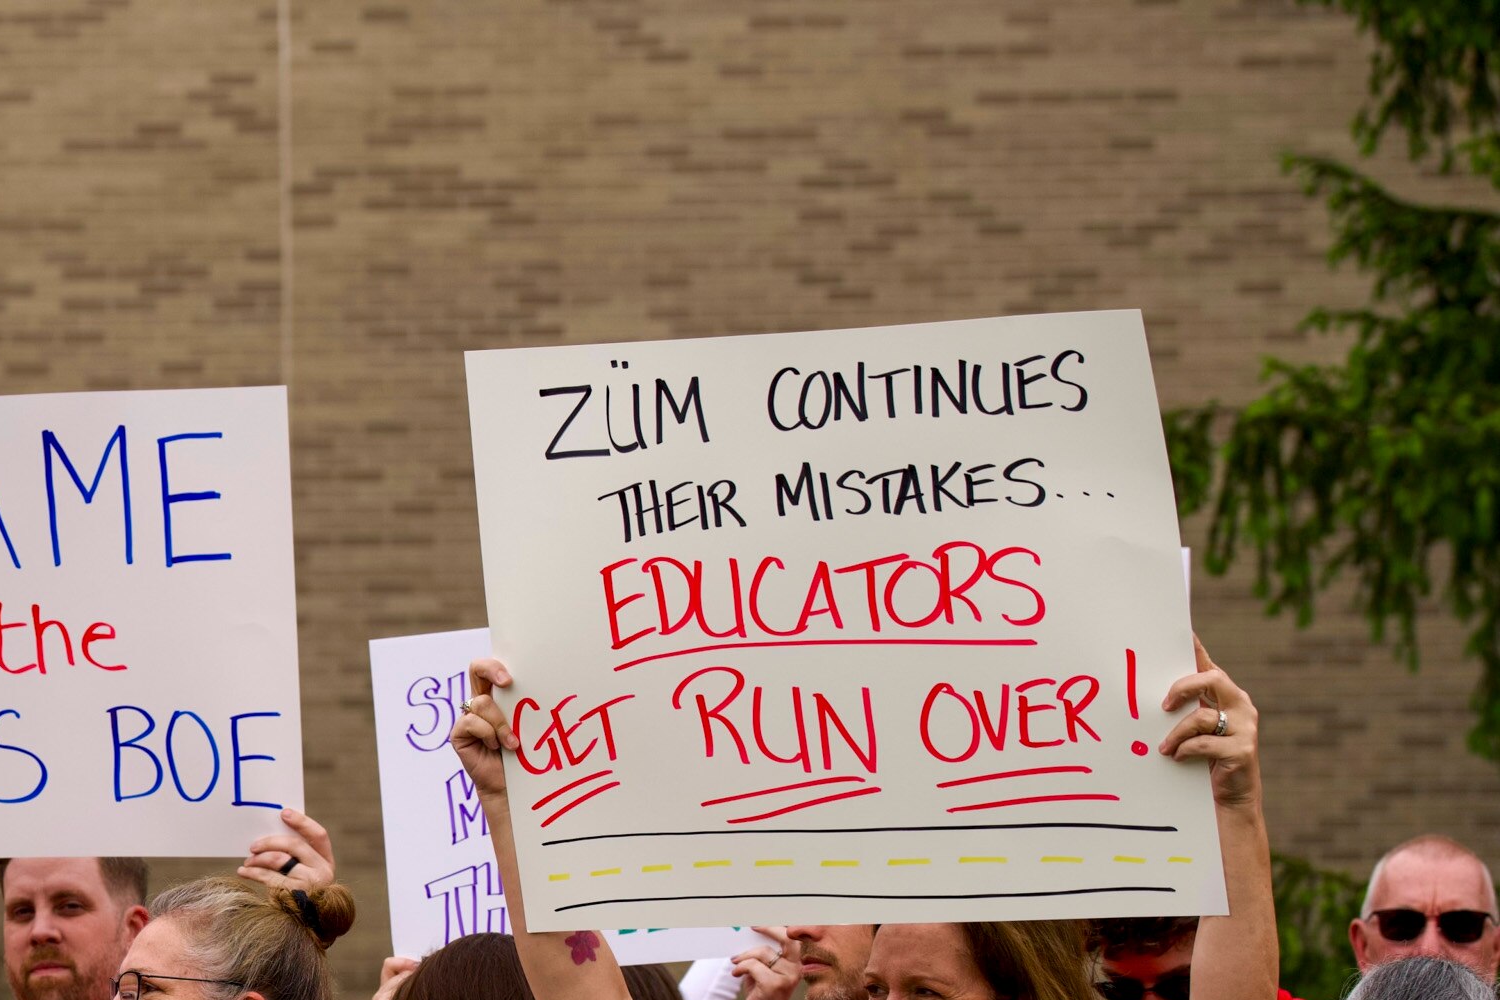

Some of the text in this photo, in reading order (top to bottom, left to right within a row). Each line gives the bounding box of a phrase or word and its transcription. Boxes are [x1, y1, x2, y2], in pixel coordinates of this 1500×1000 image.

[539, 349, 1089, 460] ZÜM CONTINUES
[598, 457, 1116, 543] THEIR MISTAKES...
[600, 540, 1047, 650] EDUCATORS
[106, 704, 284, 810] BOE
[512, 648, 1149, 775] GET RUN OVER!
